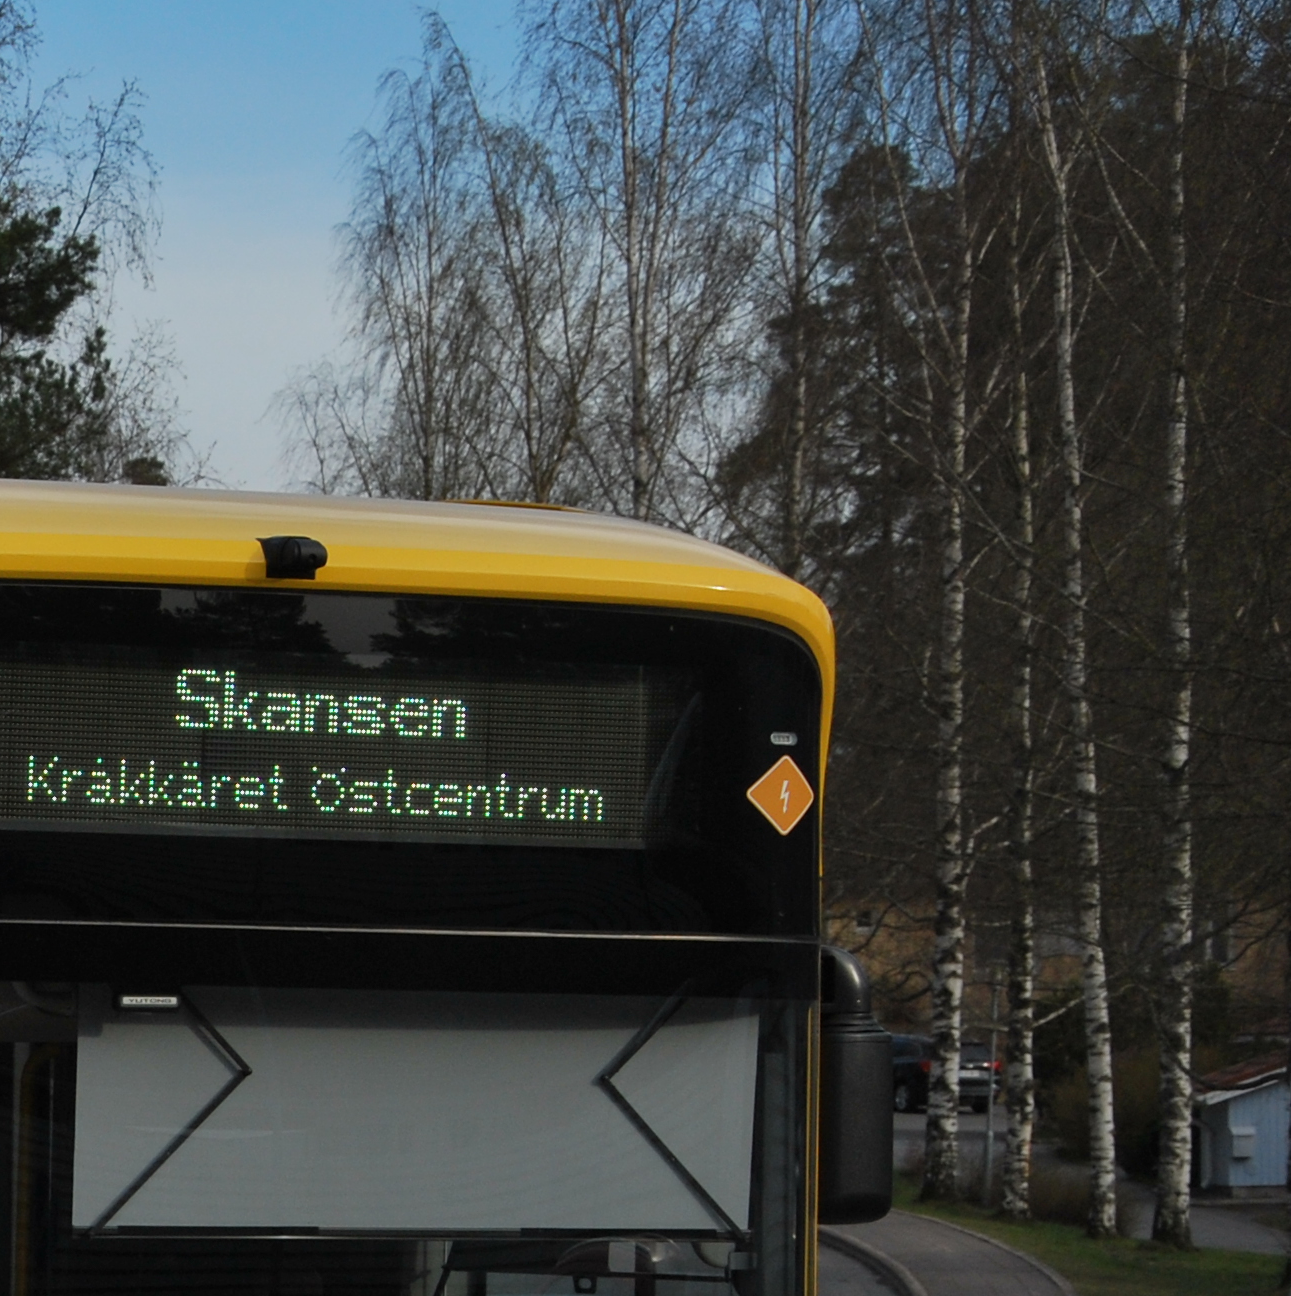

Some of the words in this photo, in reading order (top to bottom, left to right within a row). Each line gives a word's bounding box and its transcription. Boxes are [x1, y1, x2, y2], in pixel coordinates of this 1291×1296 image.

[175, 668, 468, 739] Skansen
[26, 754, 289, 811] Kråkkäret
[309, 765, 605, 823] Östcentrum
